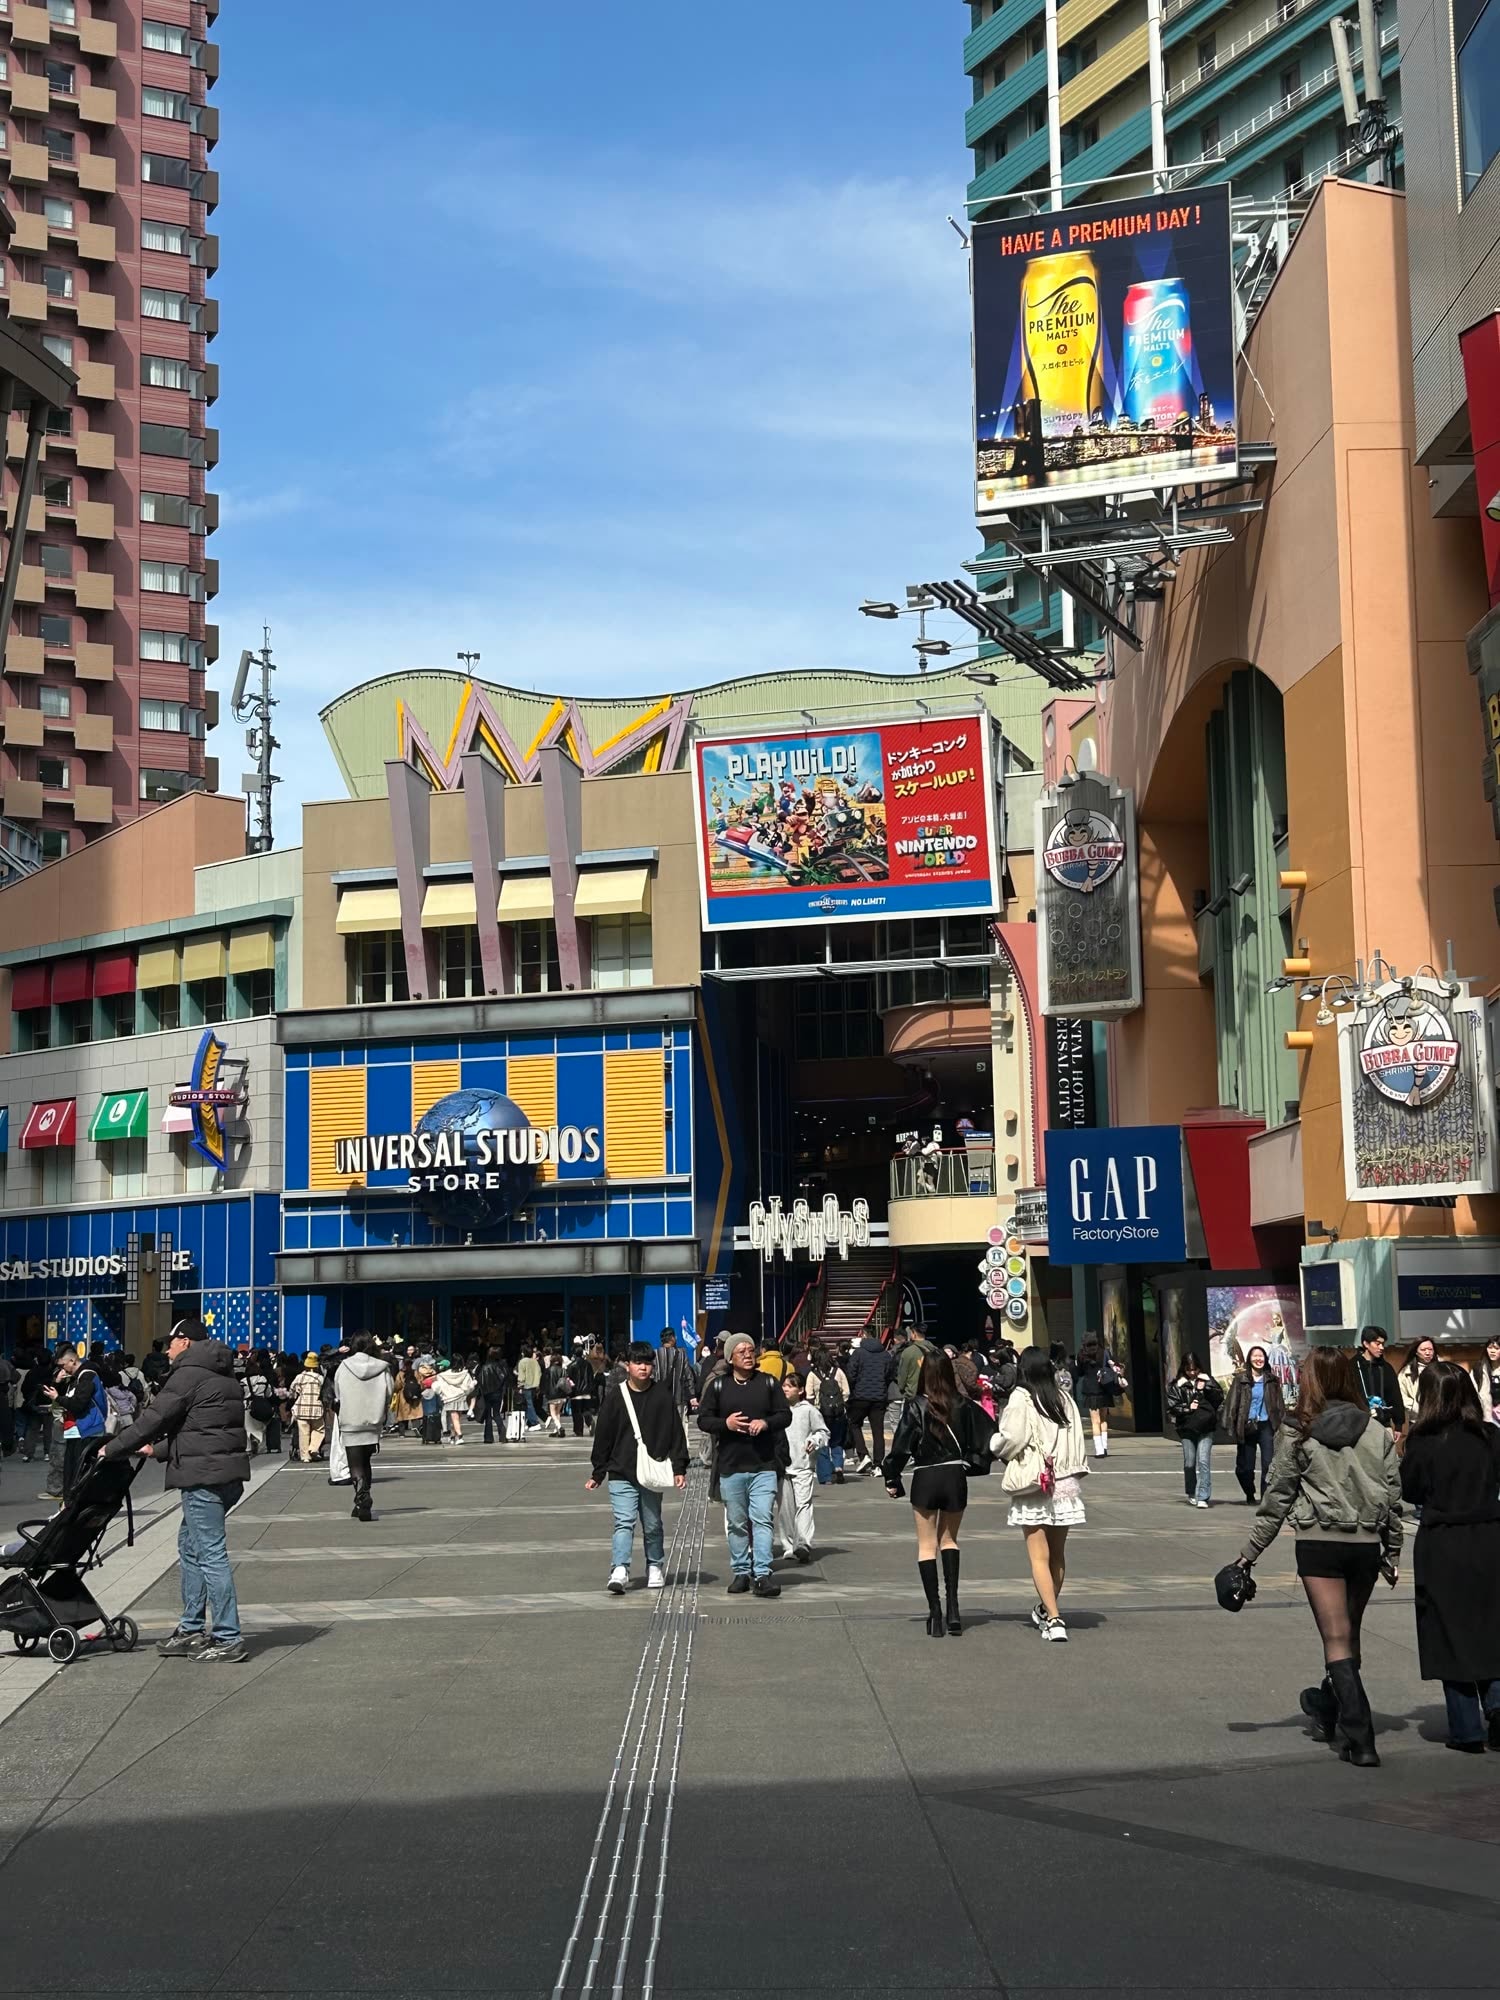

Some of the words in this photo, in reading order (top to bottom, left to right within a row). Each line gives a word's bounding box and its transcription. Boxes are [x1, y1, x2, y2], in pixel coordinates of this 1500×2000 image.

[1001, 230, 1045, 256] HAVE
[1051, 227, 1063, 248] A
[1069, 214, 1151, 246] PREMIUM
[1029, 312, 1096, 335] PREMIUM
[1046, 328, 1079, 341] MALT'S
[887, 733, 967, 766] ドンキーコング
[727, 752, 787, 782] PLAY
[891, 759, 936, 781] が加わり
[917, 824, 953, 837] SUPER
[894, 835, 978, 855] NINTENDO
[1045, 847, 1086, 866] BUBBA
[1088, 844, 1122, 859] GUMP
[911, 850, 966, 868] WORLD
[850, 899, 862, 907] NO
[1362, 1047, 1411, 1072] BUBBA
[1413, 1043, 1456, 1062] GUMP
[1379, 1065, 1413, 1078] SHRIMP
[1058, 1077, 1071, 1121] CITY
[1072, 1070, 1085, 1130] HOTEL
[335, 1129, 467, 1174] UNIVERSAL
[476, 1125, 601, 1167] STUDIOS
[408, 1172, 501, 1194] STORE
[1069, 1155, 1158, 1223] GAP
[38, 1254, 121, 1278] STUDIOS
